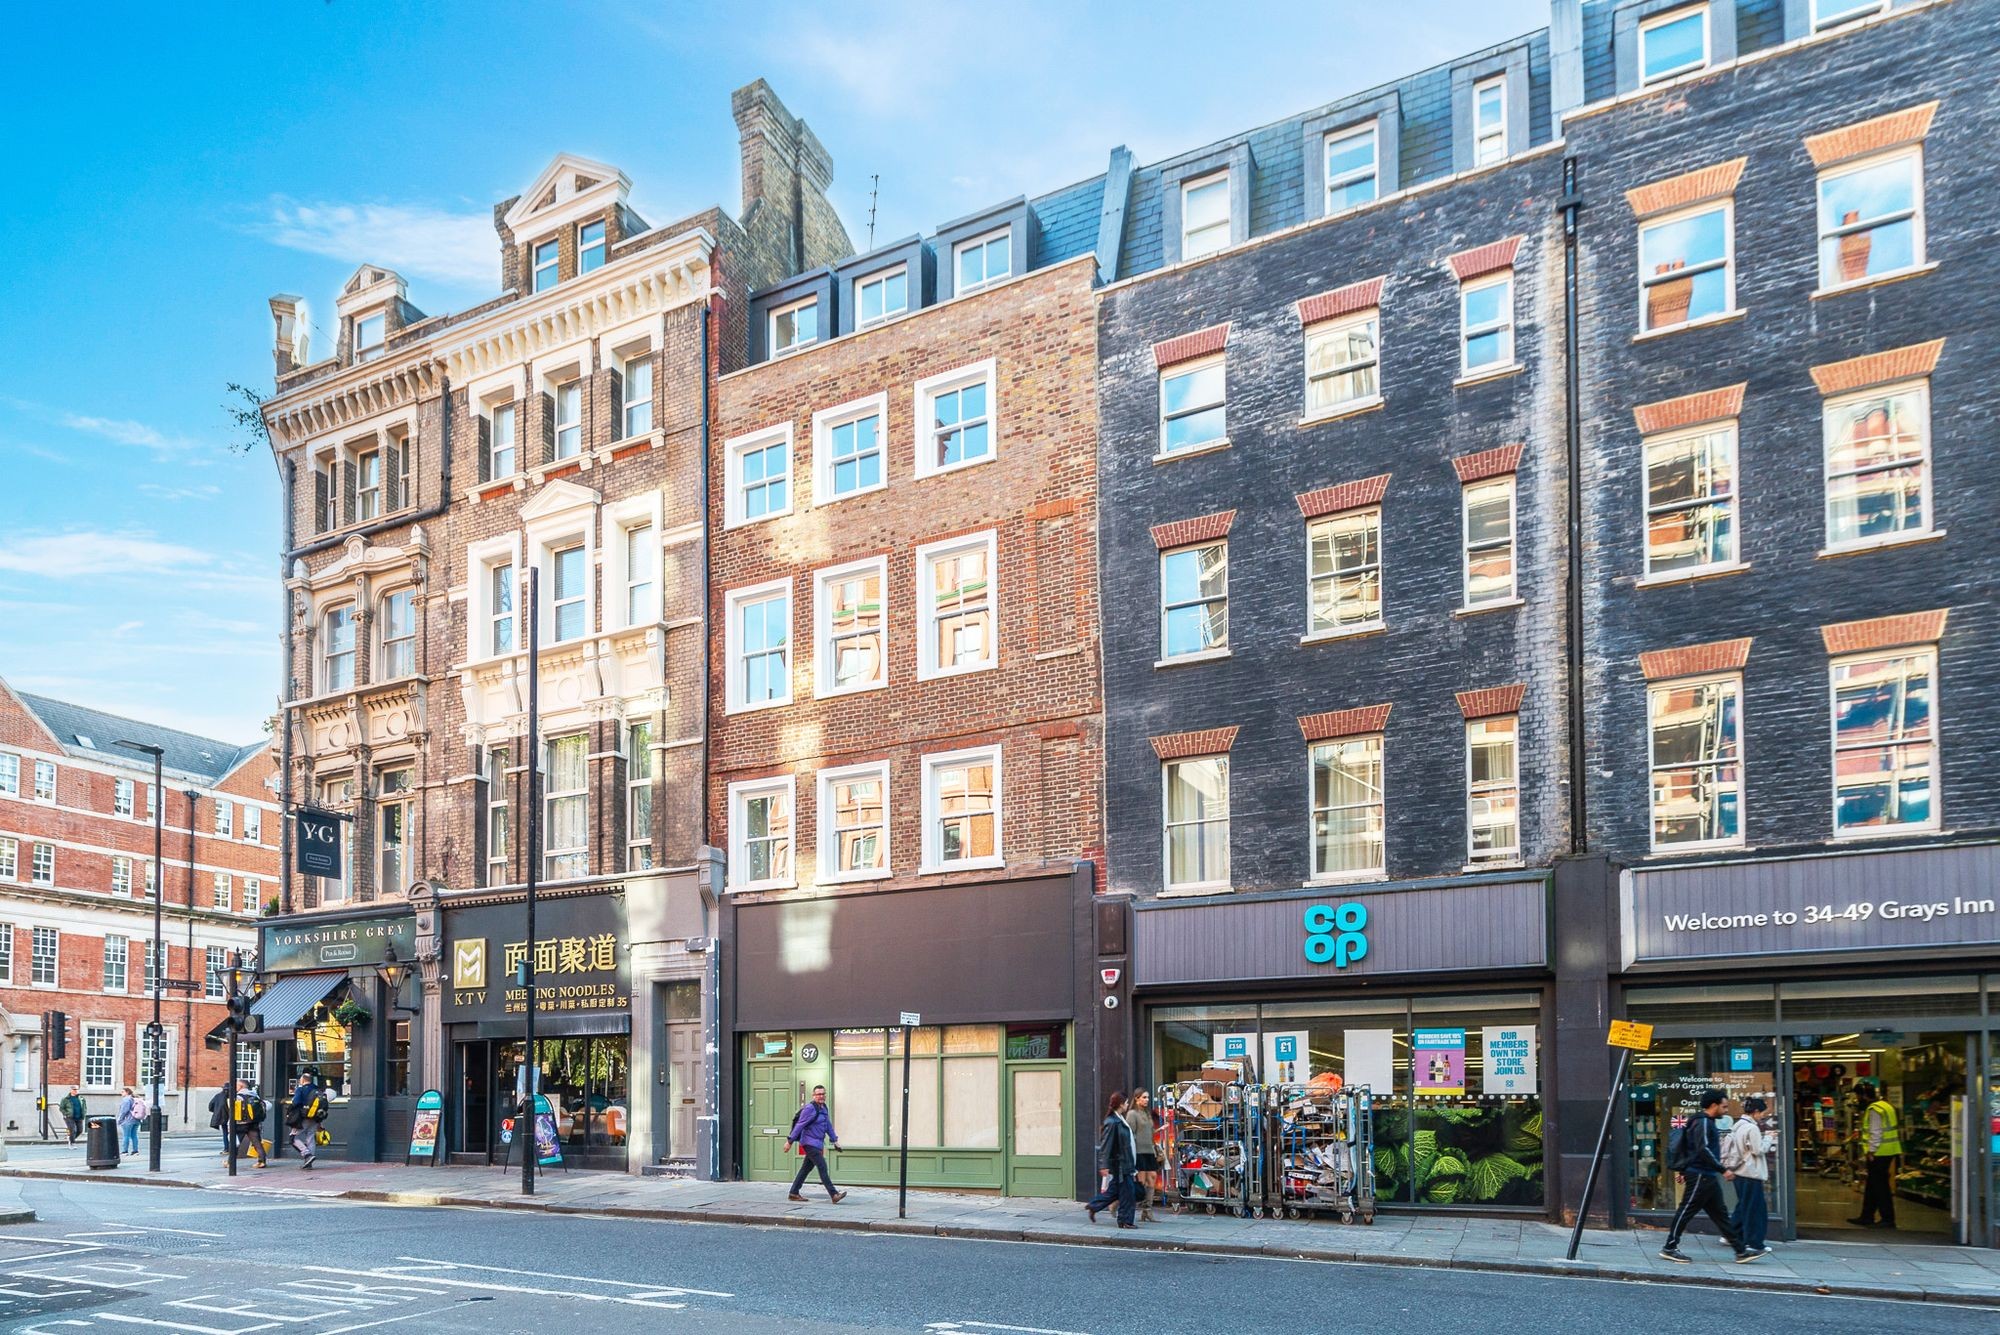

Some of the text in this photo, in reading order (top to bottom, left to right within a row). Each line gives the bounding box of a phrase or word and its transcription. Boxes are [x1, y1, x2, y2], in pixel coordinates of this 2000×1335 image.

[1664, 896, 1995, 933] Welcome to 34-49 Grays Inn
[274, 924, 405, 946] YORKSHIRE GREY
[505, 984, 615, 1000] MEEING NOODLES
[454, 991, 487, 1006] KTV
[616, 997, 627, 1008] 35
[1500, 1031, 1517, 1039] OUR
[1280, 1042, 1292, 1053] £1
[1490, 1040, 1529, 1049] MEMBERS
[803, 1047, 816, 1059] 37
[1510, 1049, 1529, 1057] THIS
[1496, 1058, 1525, 1066] STORE.
[1494, 1067, 1528, 1075] JOIN US.
[1679, 1075, 1713, 1083] Welcome
